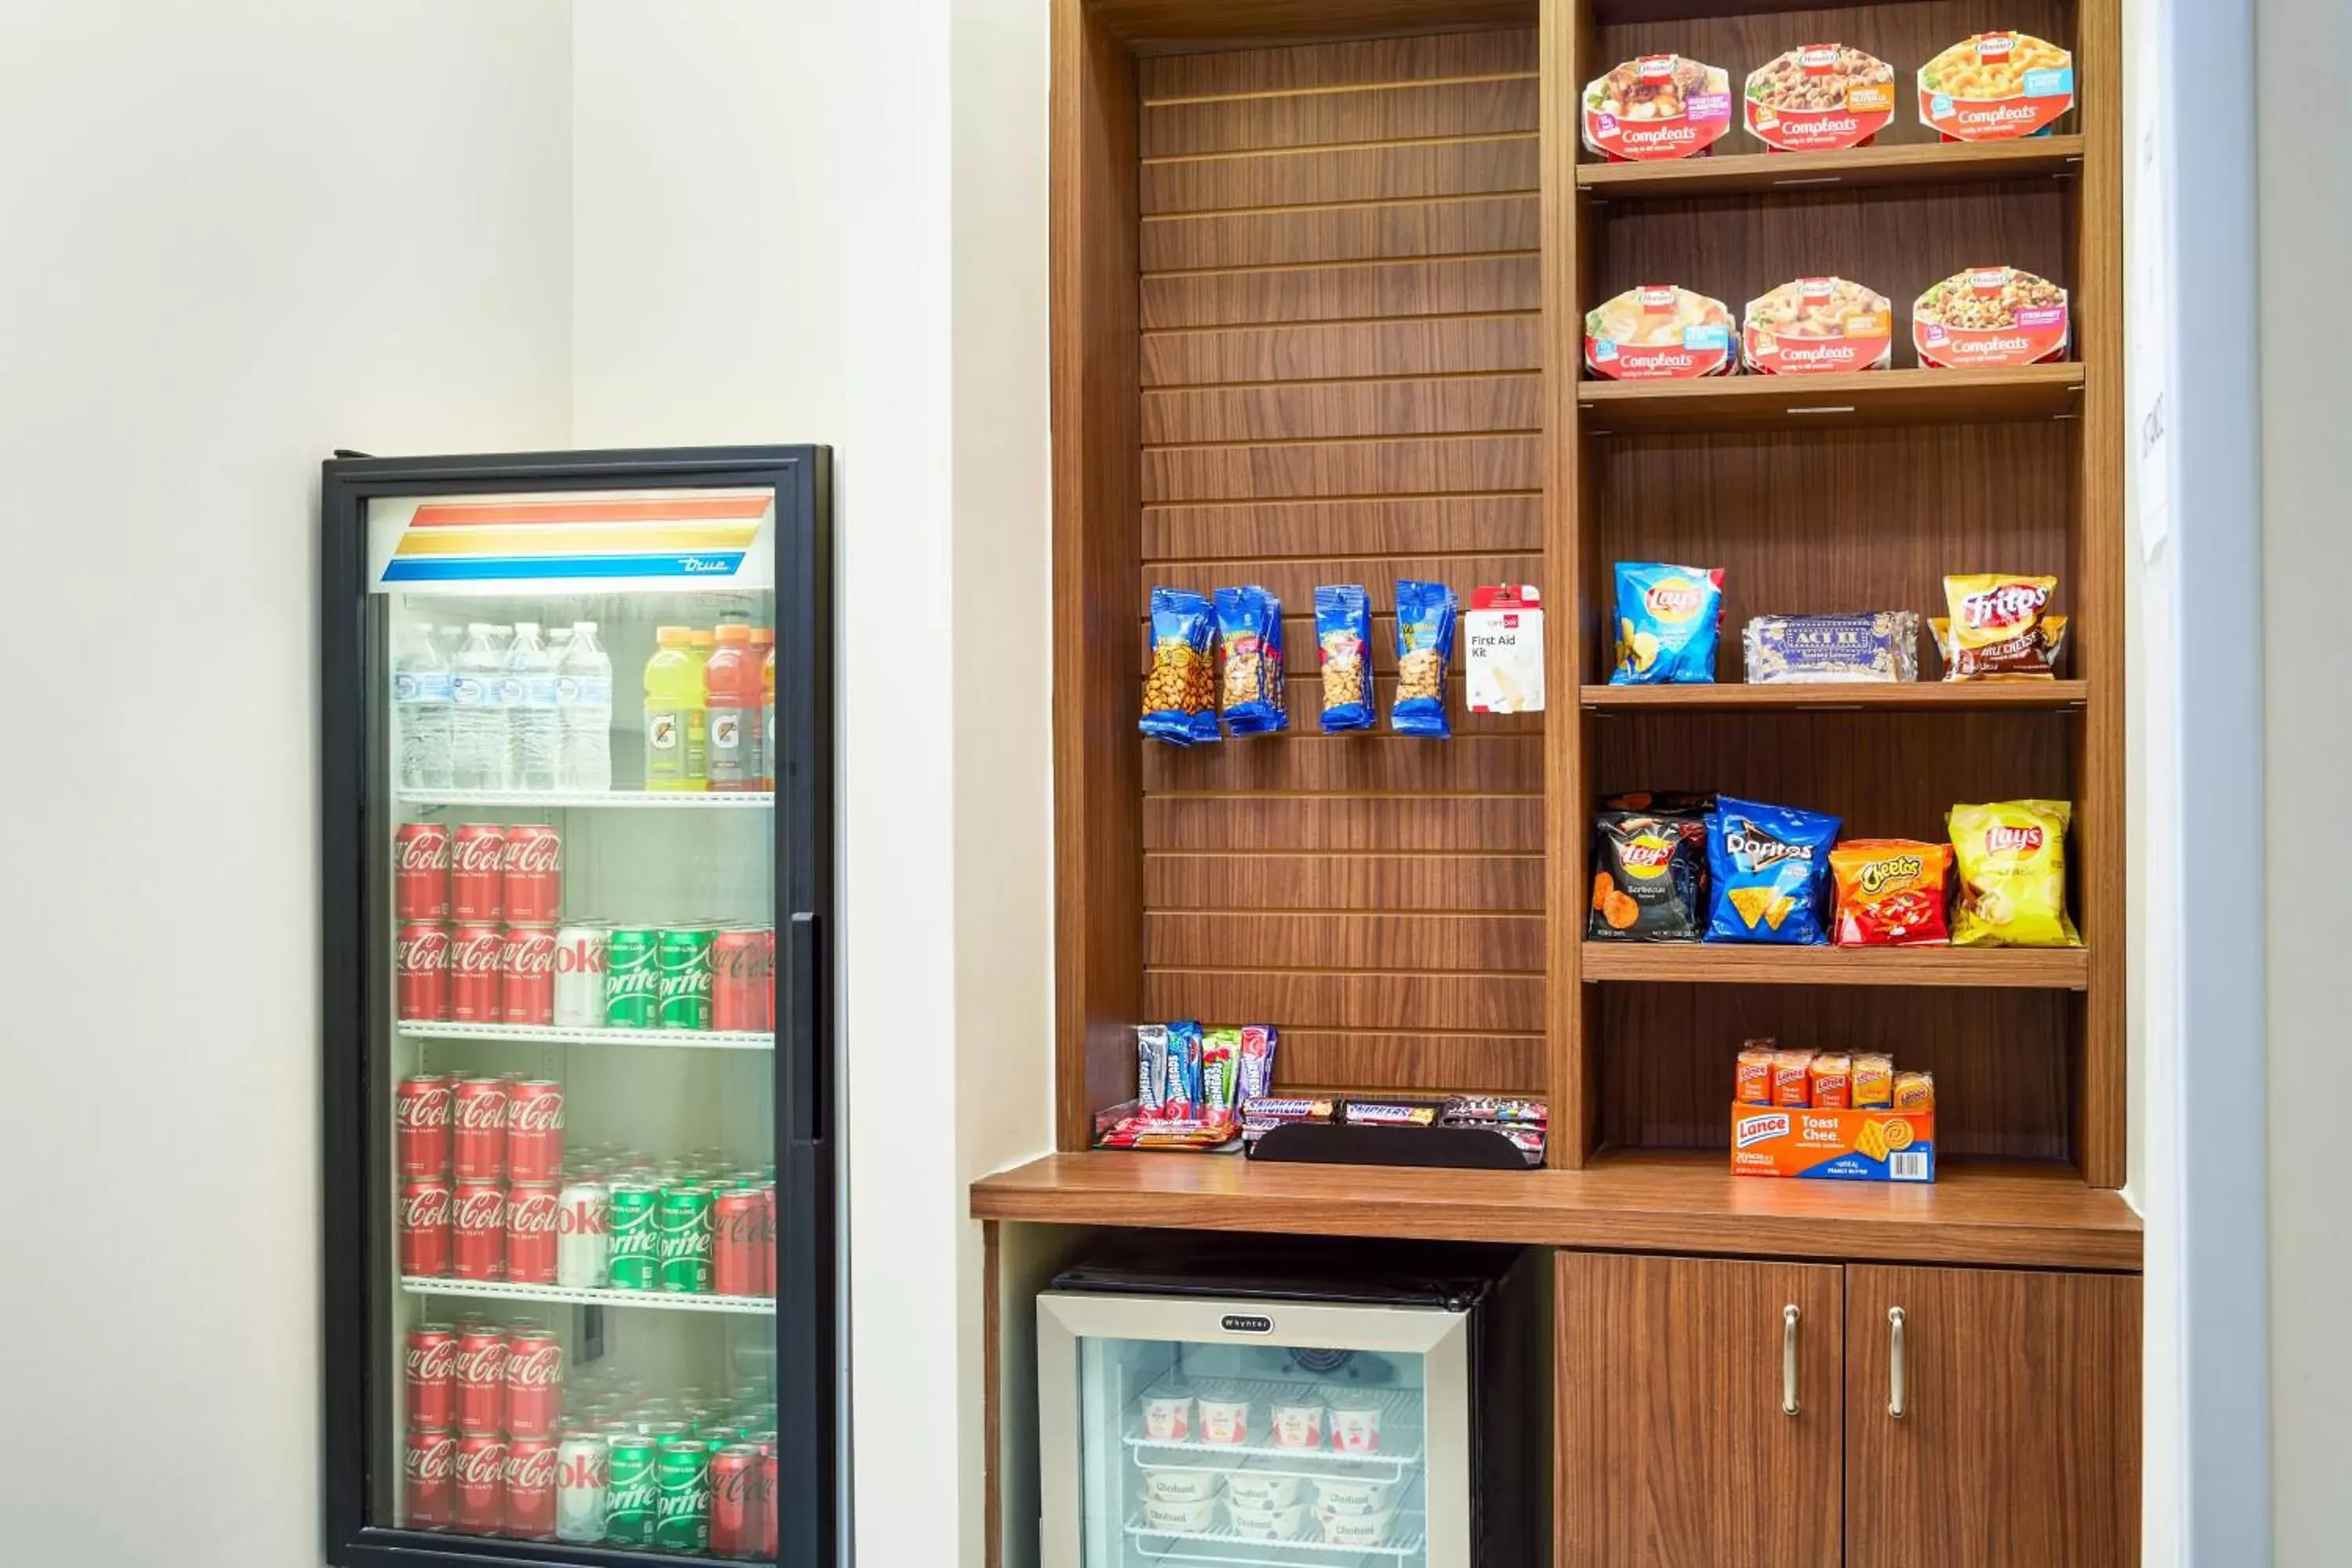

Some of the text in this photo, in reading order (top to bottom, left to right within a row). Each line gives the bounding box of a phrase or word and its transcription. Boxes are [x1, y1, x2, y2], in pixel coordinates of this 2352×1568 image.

[1958, 105, 2037, 126] Compleats
[1621, 125, 1697, 145] Compleats
[1782, 117, 1857, 138] Compleats
[1780, 343, 1857, 363] Compleats
[1951, 336, 2031, 355] Compleats
[1621, 352, 1694, 371] Compleats
[677, 557, 728, 572] true
[1964, 586, 2048, 629] Fritos
[1472, 634, 1516, 646] First Aid
[1796, 632, 1859, 644] ACT II
[1472, 648, 1487, 658] Kit
[650, 714, 677, 749] G
[712, 714, 739, 749] G
[1726, 833, 1815, 860] Doritos
[1990, 826, 2042, 852] Lay's
[1621, 843, 1670, 866] Lay's
[1861, 855, 1922, 894] Cheetos
[607, 966, 659, 999] prite
[659, 967, 712, 1000] prite
[1139, 1061, 1157, 1112] AIRHEADS
[1168, 1054, 1188, 1105] AIRHEADS
[1210, 1063, 1225, 1112] AIRHEADS
[1245, 1056, 1261, 1099] AIRHEAD
[1777, 1069, 1804, 1084] Lance
[1818, 1077, 1844, 1091] Lance
[1740, 1118, 1787, 1138] Lance
[1801, 1115, 1839, 1129] Toast
[609, 1228, 657, 1254] prite
[661, 1229, 711, 1260] prite
[607, 1483, 656, 1512] prite
[1156, 1482, 1195, 1494] Chobani
[657, 1488, 710, 1519] prite
[1335, 1524, 1374, 1535] Chobani
